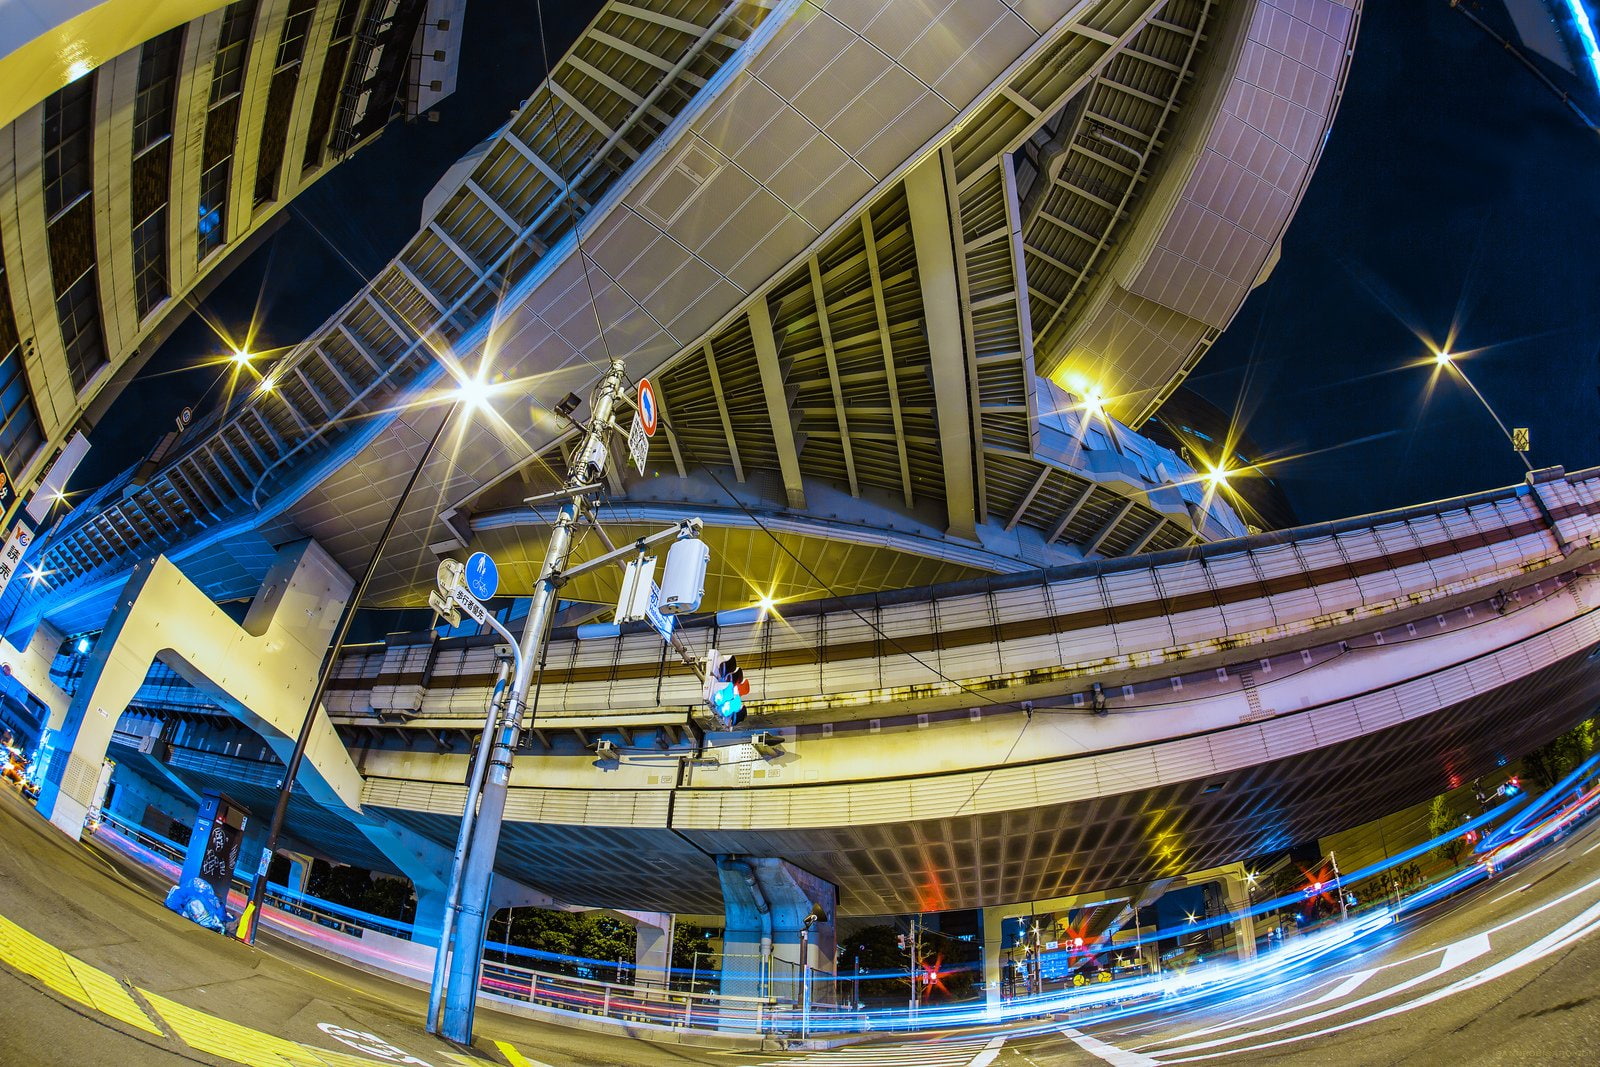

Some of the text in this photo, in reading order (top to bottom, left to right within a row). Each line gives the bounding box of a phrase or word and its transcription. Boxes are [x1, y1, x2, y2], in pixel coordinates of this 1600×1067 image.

[0, 545, 20, 590] 読売
[456, 590, 485, 620] 歩行者優先
